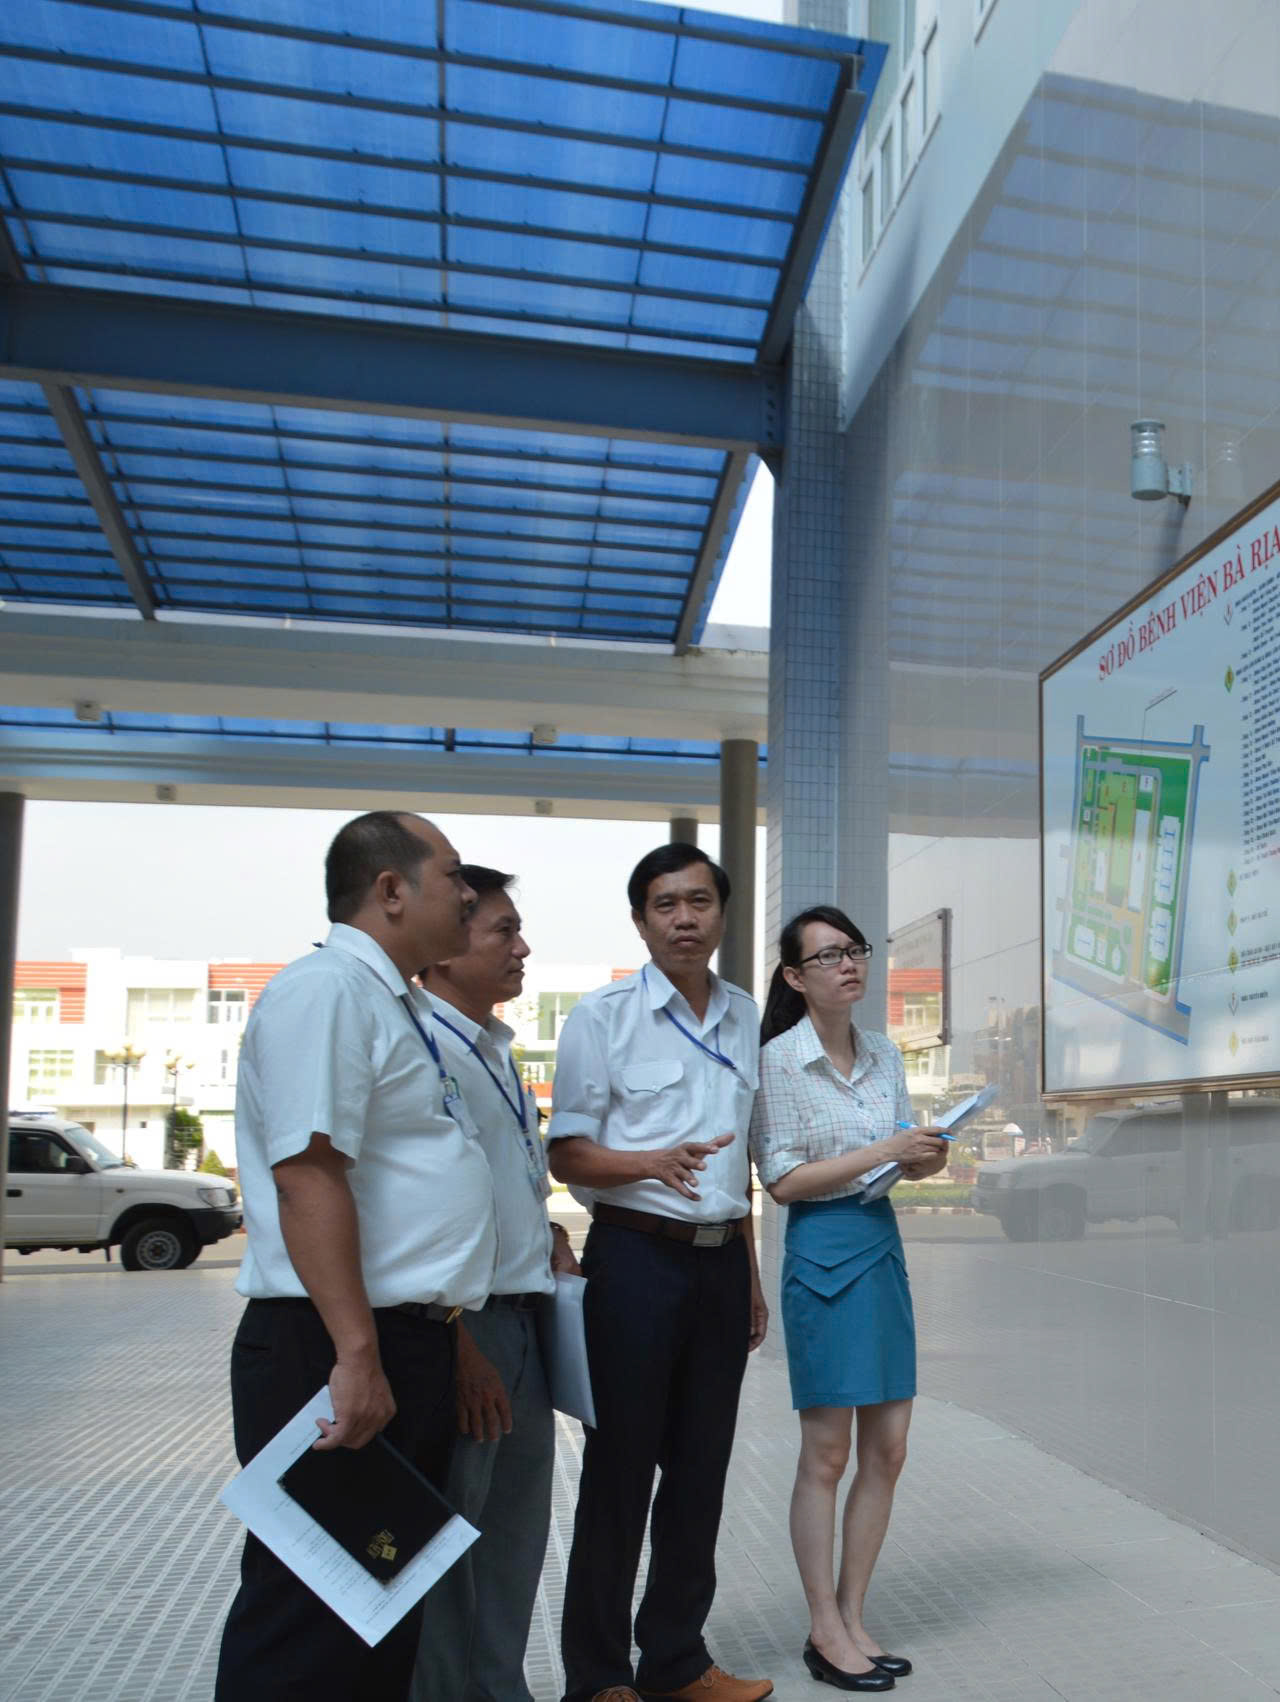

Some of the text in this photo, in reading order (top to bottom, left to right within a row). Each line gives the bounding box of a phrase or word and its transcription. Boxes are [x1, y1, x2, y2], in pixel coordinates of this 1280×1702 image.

[1117, 621, 1135, 668] ĐỒ
[1138, 601, 1176, 652] BỆNH
[1180, 570, 1217, 620] VIỆN
[1222, 544, 1245, 592] BÀ
